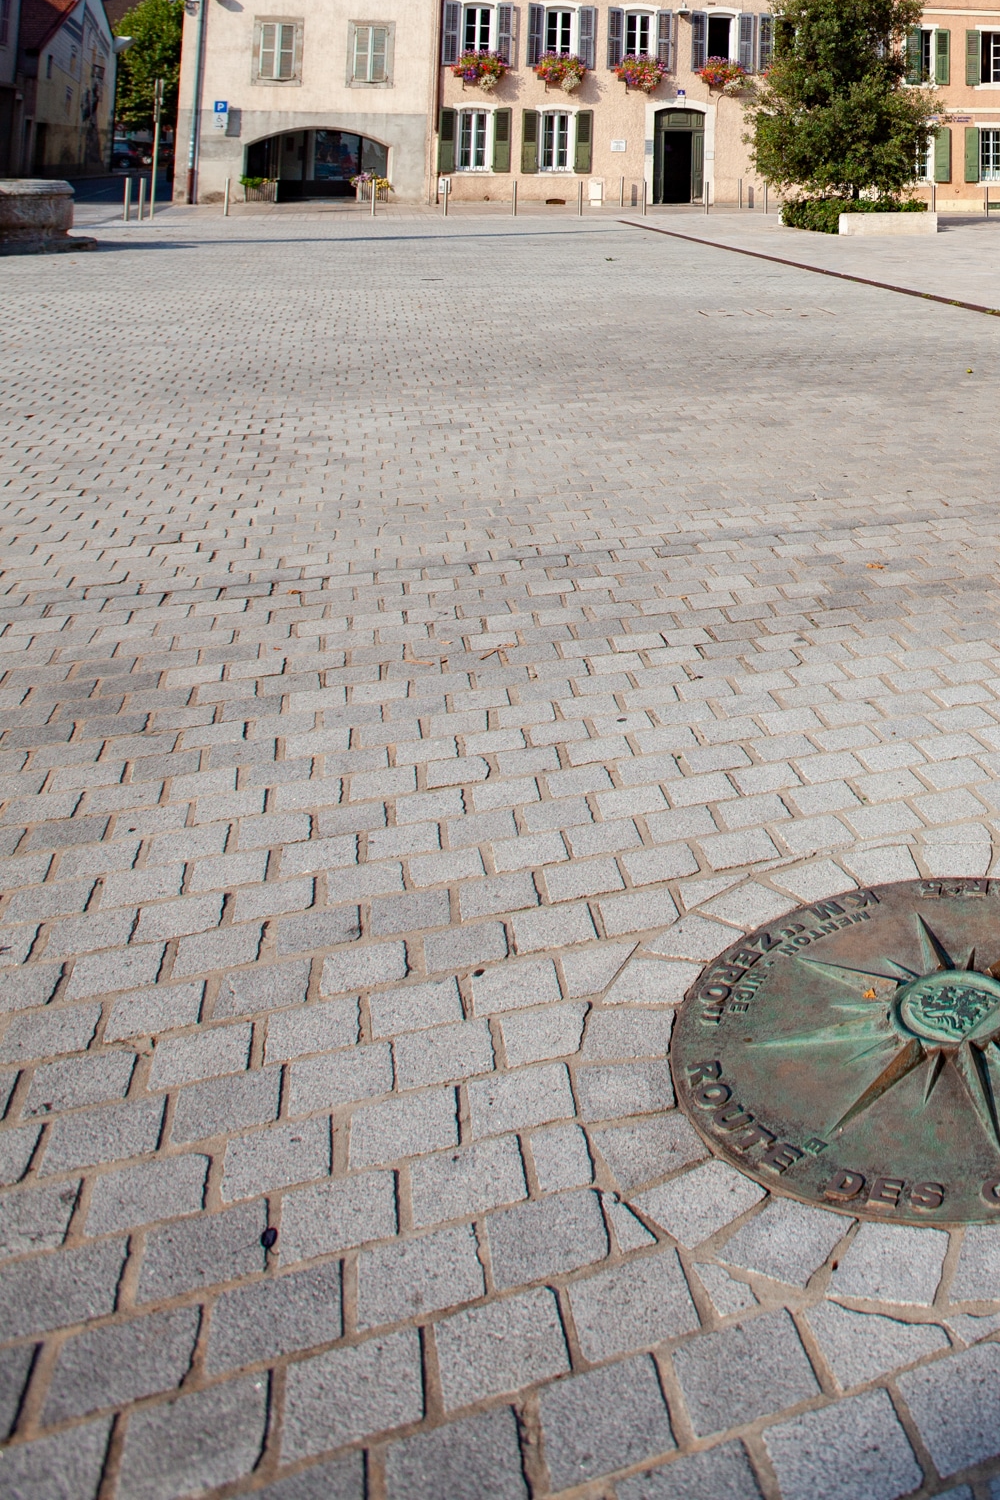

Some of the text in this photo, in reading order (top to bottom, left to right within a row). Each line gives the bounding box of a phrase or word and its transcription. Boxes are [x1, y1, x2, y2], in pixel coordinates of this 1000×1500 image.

[217, 102, 225, 111] P
[809, 889, 881, 922] KM
[777, 910, 871, 957] MENTON
[728, 972, 768, 1013] NICE
[686, 1060, 804, 1176] ROUTE
[824, 1168, 946, 1211] DES
[803, 1136, 829, 1157] E
